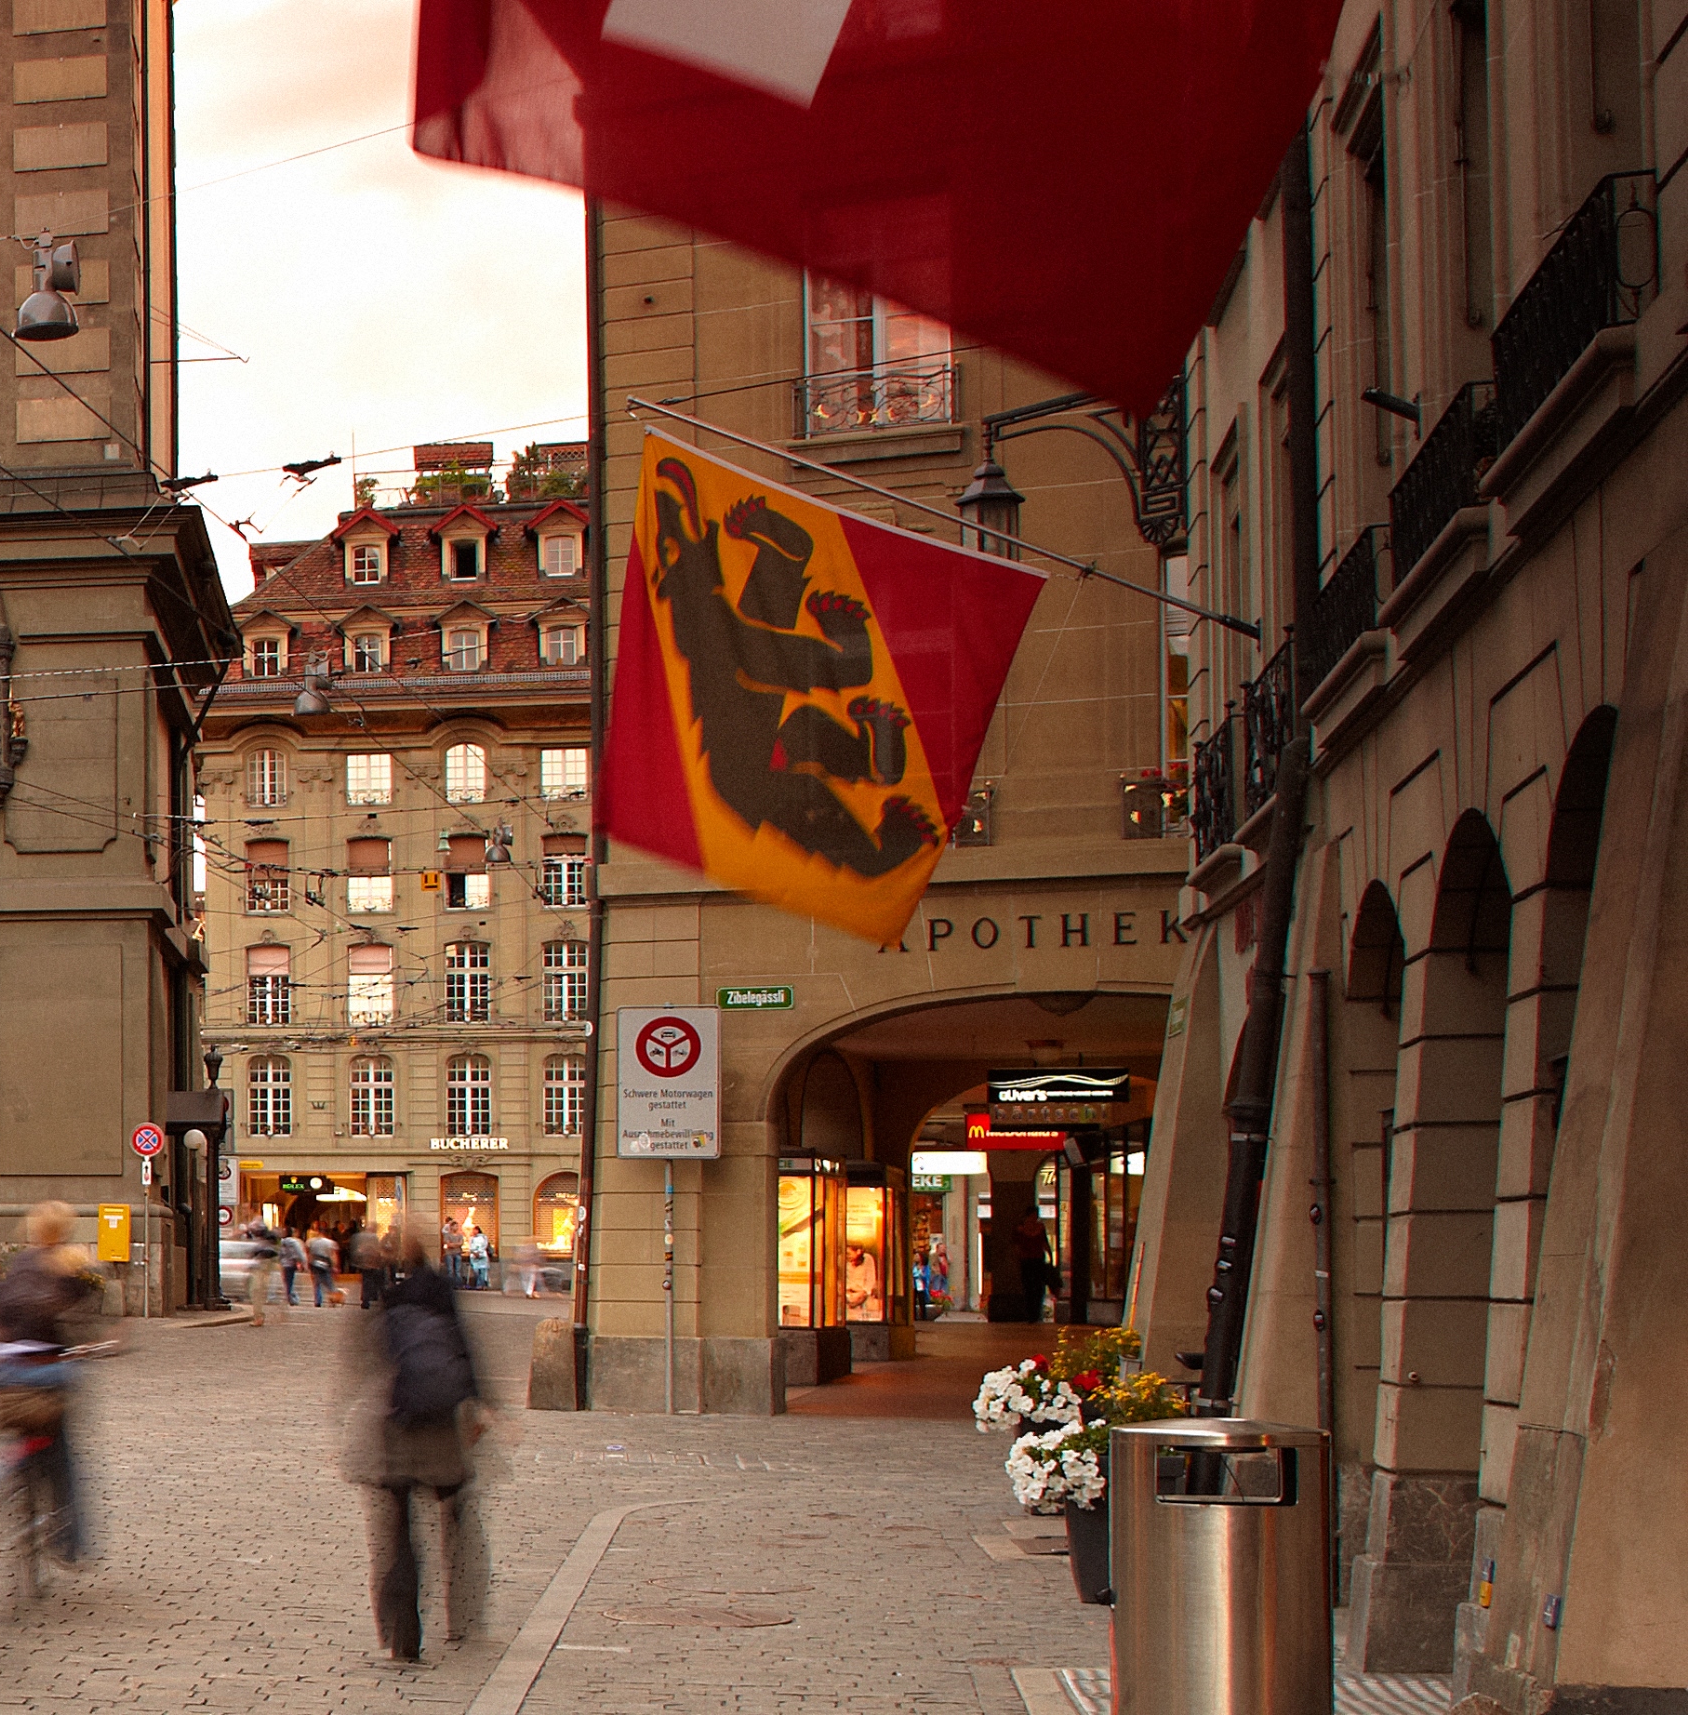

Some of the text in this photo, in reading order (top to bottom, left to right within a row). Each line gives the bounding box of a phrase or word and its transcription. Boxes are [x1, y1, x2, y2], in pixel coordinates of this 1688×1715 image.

[878, 909, 1188, 953] POTHEK
[726, 989, 785, 1006] Zibelegässli
[623, 1089, 713, 1102] Schwere Motorwagen
[648, 1101, 687, 1111] gestattet
[660, 1118, 675, 1128] Mit
[430, 1138, 509, 1150] BUCHERER
[650, 1141, 688, 1151] gestattet
